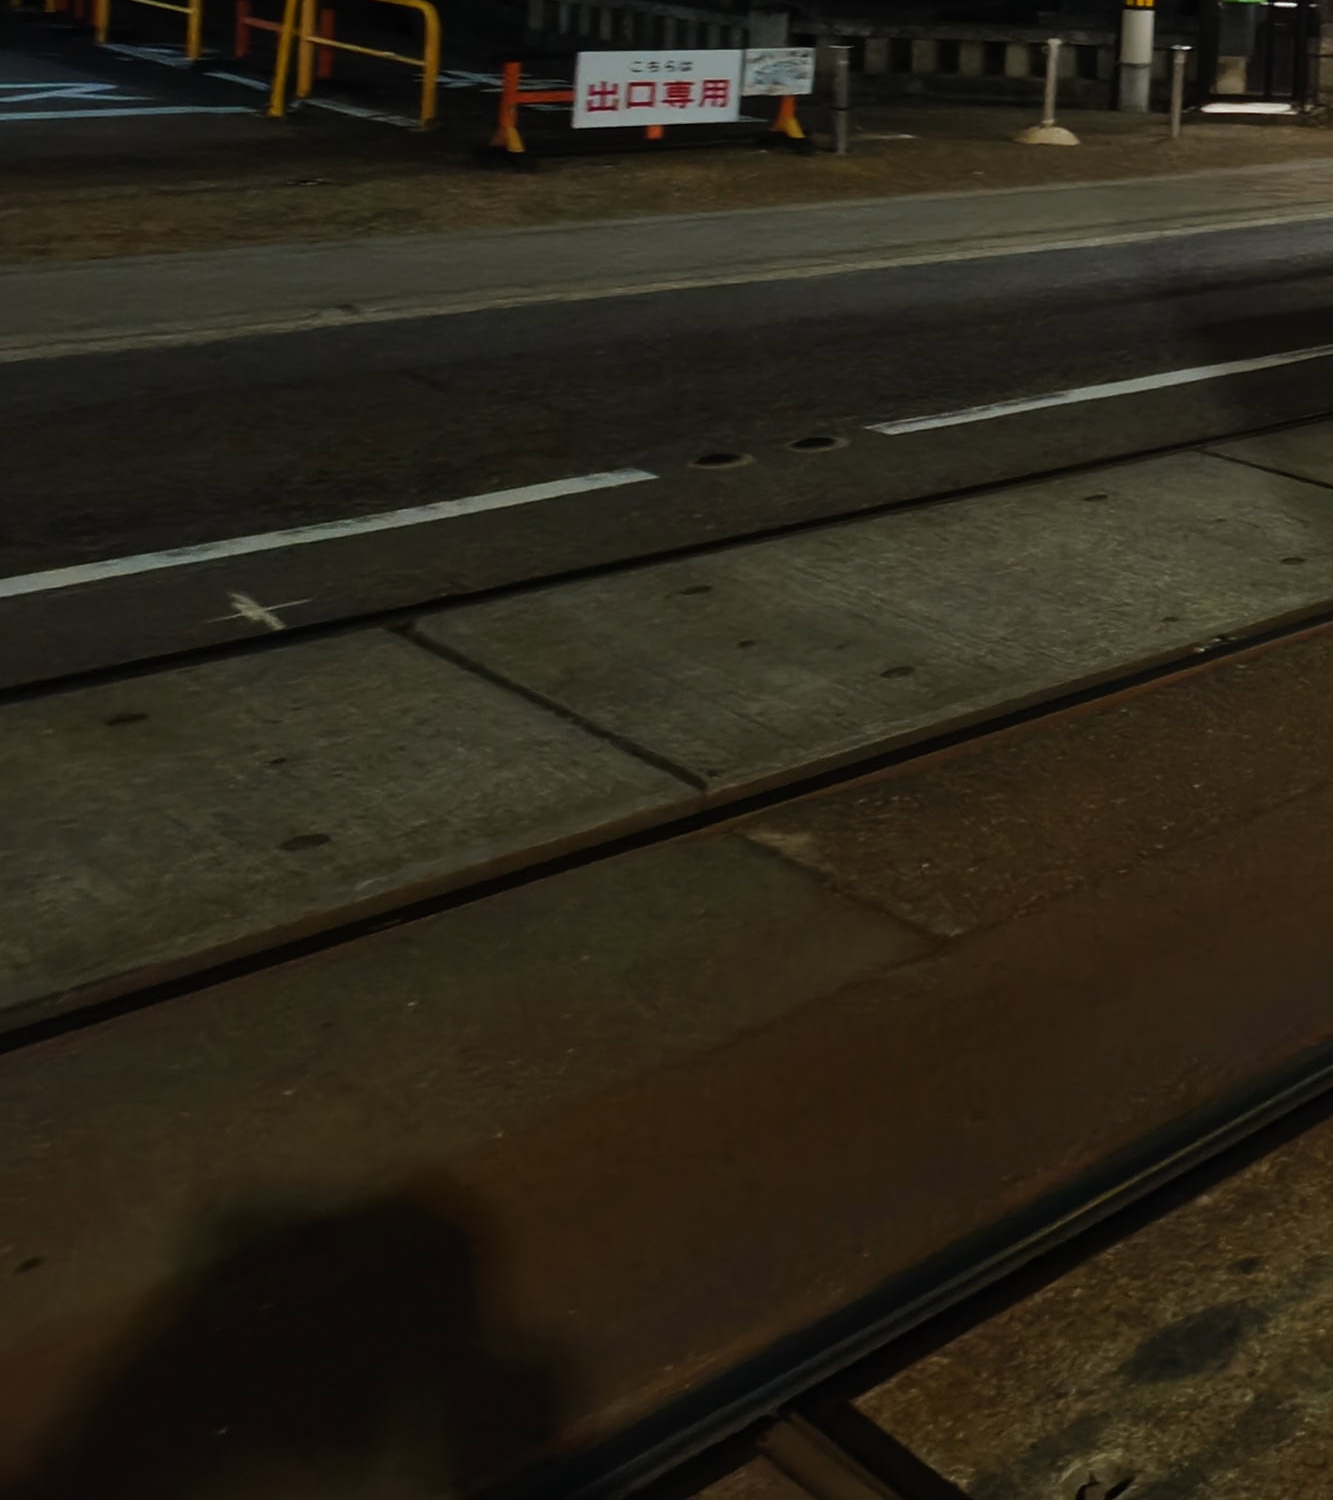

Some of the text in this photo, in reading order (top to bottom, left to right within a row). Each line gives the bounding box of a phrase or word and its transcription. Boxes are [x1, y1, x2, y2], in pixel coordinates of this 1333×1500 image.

[629, 60, 695, 74] こちらは
[586, 78, 730, 113] 出口専用
